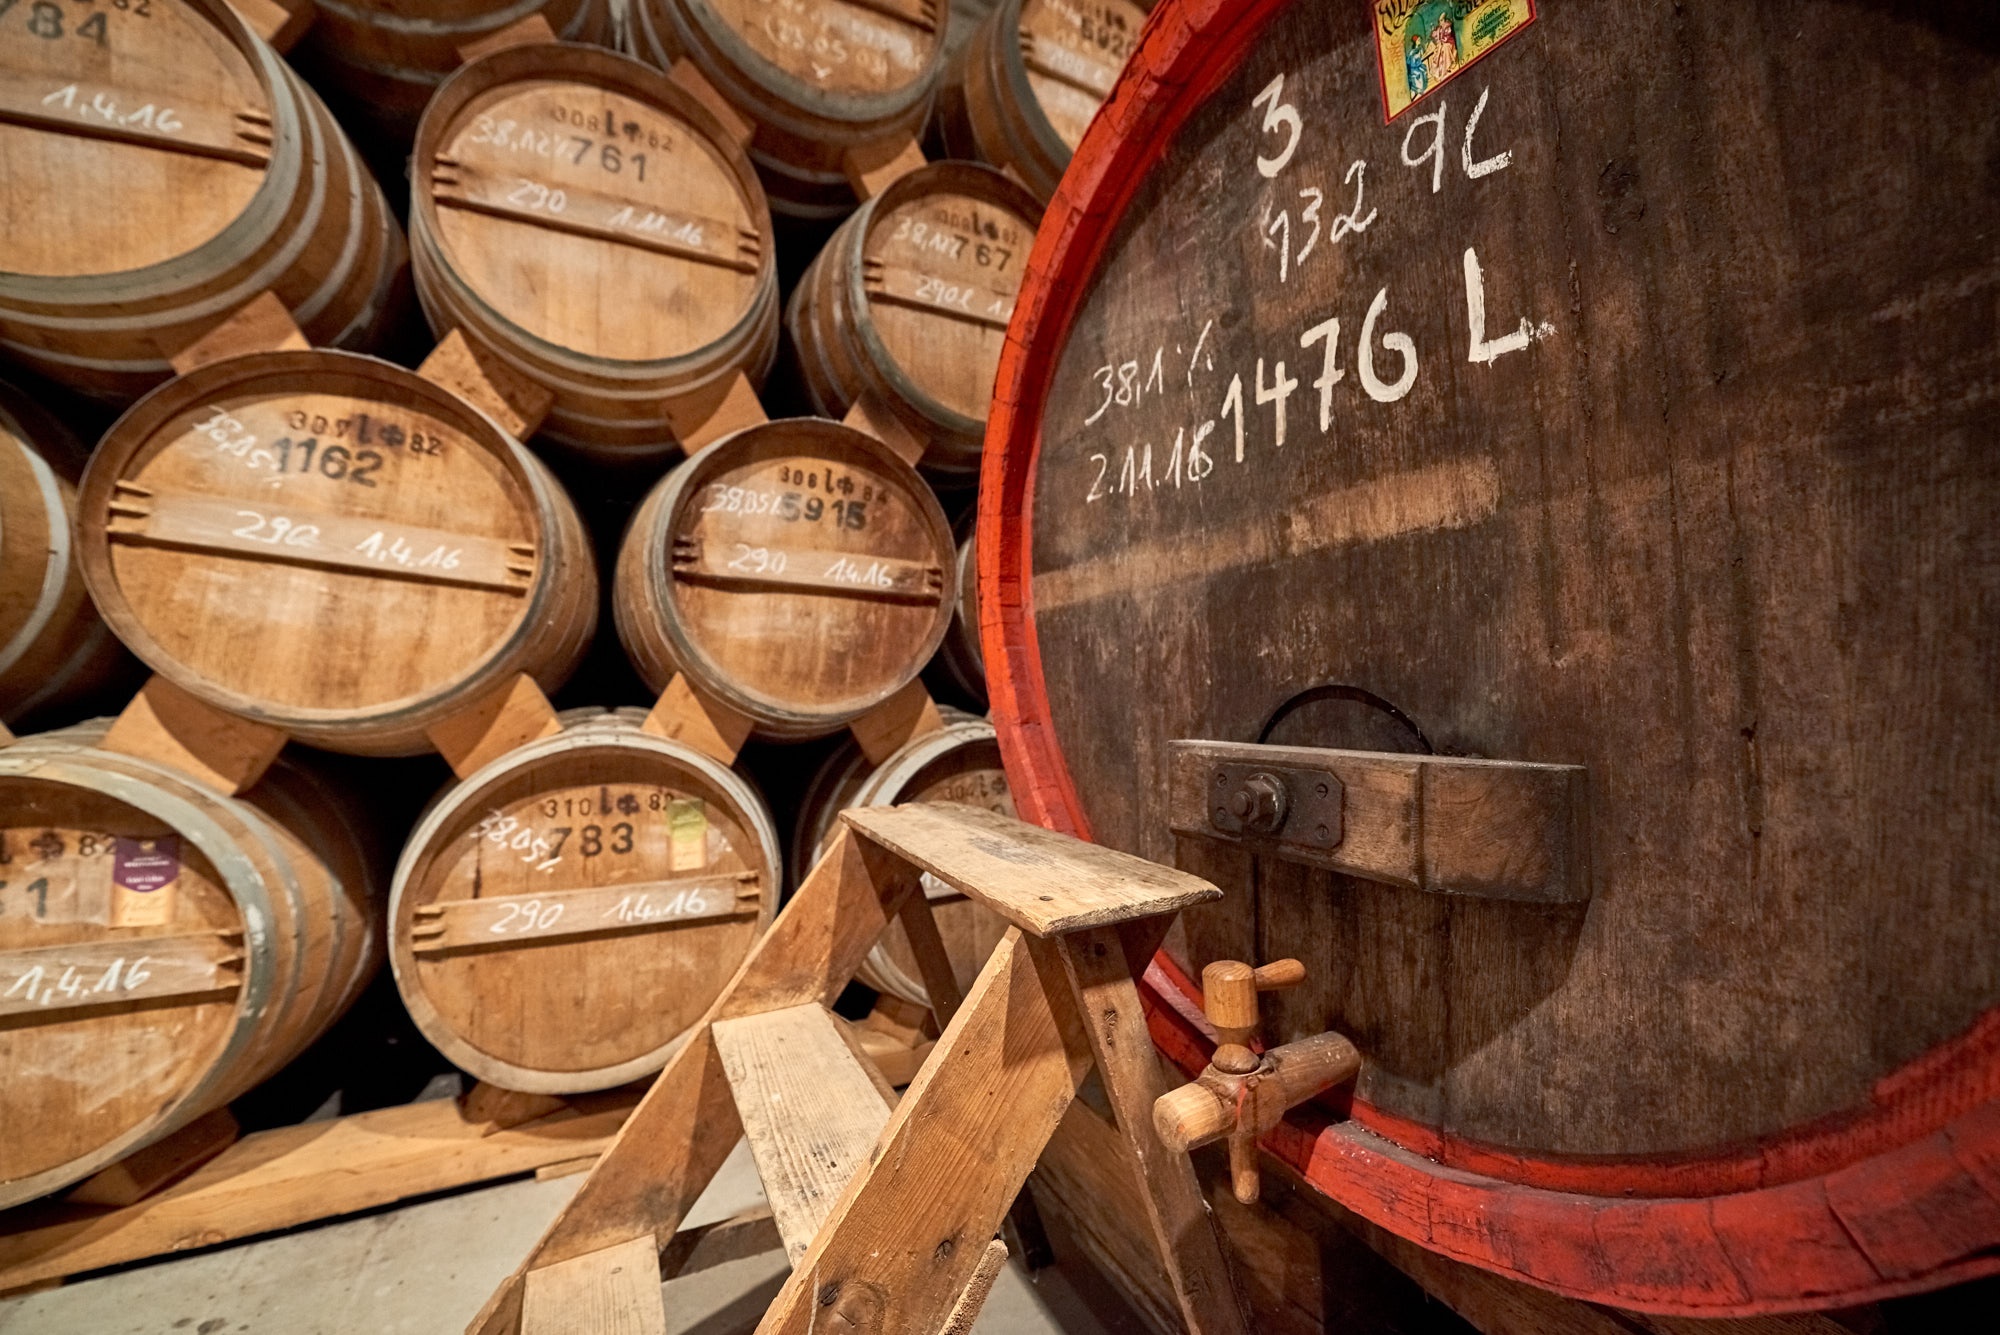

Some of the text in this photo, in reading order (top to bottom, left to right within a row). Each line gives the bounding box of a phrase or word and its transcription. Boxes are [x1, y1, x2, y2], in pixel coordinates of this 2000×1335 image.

[0, 0, 110, 48] 84
[1252, 72, 1303, 178] 3
[570, 135, 646, 182] 761
[507, 177, 567, 214] 290
[1268, 159, 1377, 284] 132
[953, 232, 1012, 272] 767
[1221, 246, 1540, 464] 1476 L
[272, 436, 384, 488] 1162
[781, 491, 867, 530] 5915
[728, 543, 788, 575] 290
[544, 798, 592, 818] 310
[549, 822, 634, 858] 783
[490, 899, 565, 934] 290
